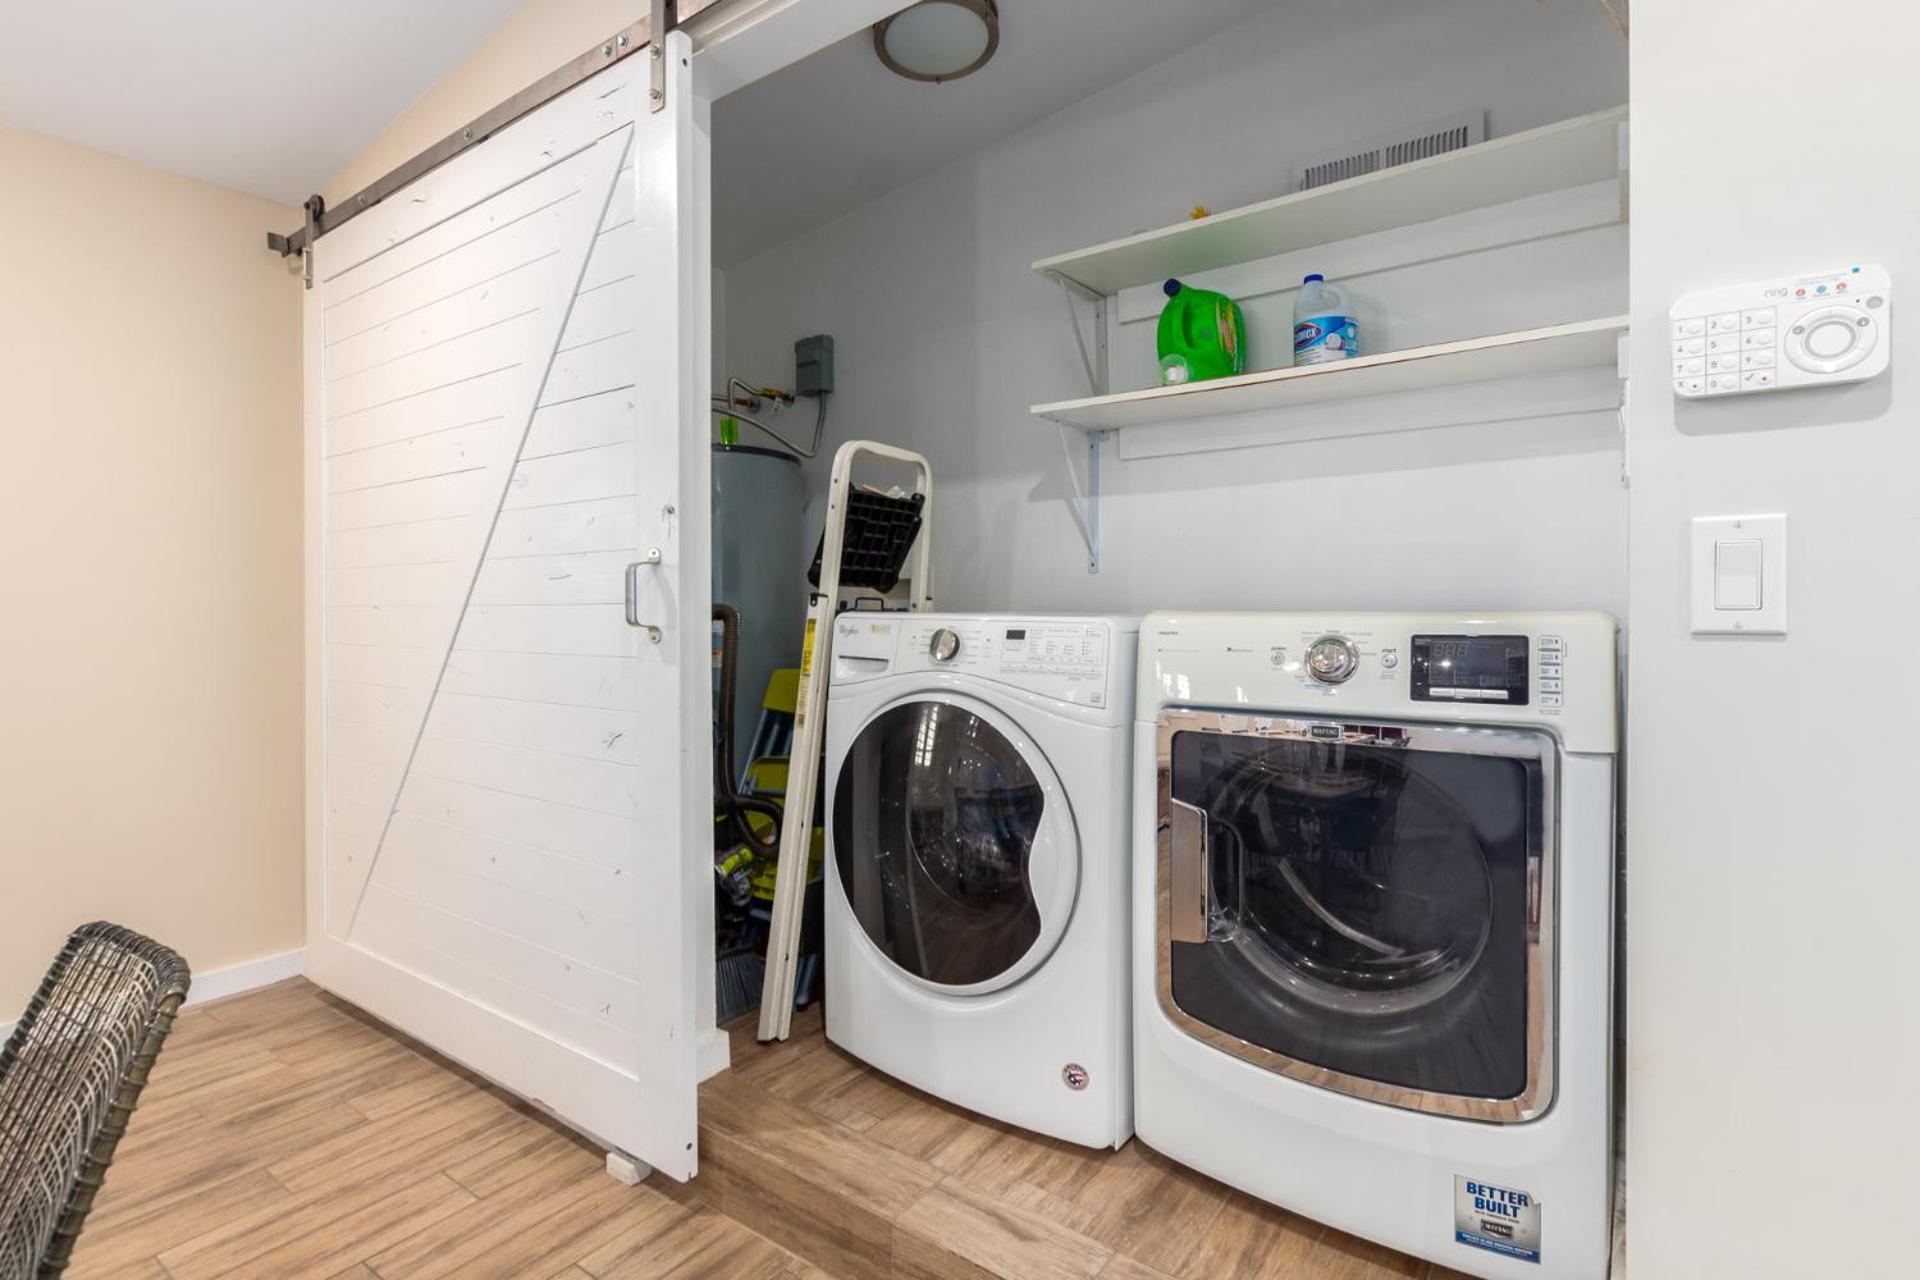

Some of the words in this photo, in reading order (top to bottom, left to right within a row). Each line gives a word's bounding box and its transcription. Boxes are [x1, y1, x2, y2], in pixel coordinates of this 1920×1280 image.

[1764, 287, 1788, 298] ring
[1710, 320, 1717, 329] 2
[1466, 1181, 1529, 1207] BETTER
[1475, 1196, 1520, 1218] BUILT
